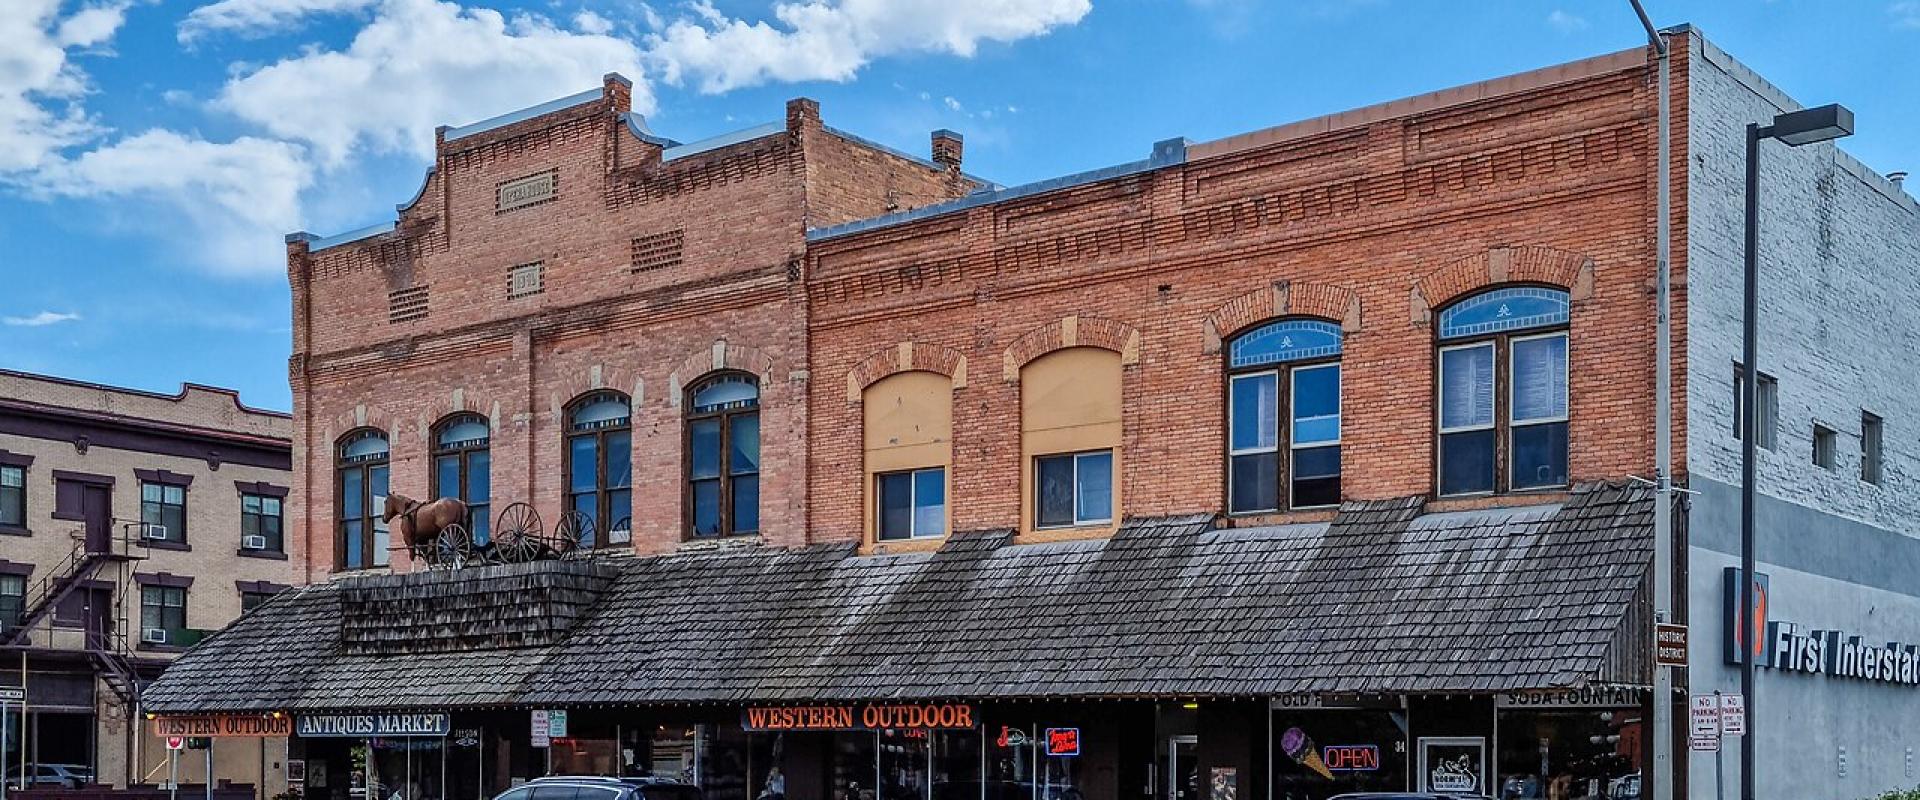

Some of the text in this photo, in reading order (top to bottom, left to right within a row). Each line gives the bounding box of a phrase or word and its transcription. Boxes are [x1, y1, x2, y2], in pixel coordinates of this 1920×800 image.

[1658, 631, 1686, 644] HISTORIC
[1658, 646, 1686, 659] DISTRICT
[1774, 622, 1827, 674] First
[1508, 686, 1642, 705] SODA FOUNTAIN
[1699, 698, 1711, 706] NO
[1727, 697, 1737, 706] NO
[748, 704, 973, 729] WESTERN OUTDOOR
[1692, 708, 1718, 716] PARKING
[158, 715, 290, 735] WESTERN OUTDOOR
[302, 713, 445, 735] ANTIQUES MARKET
[1327, 748, 1377, 768] OPEN
